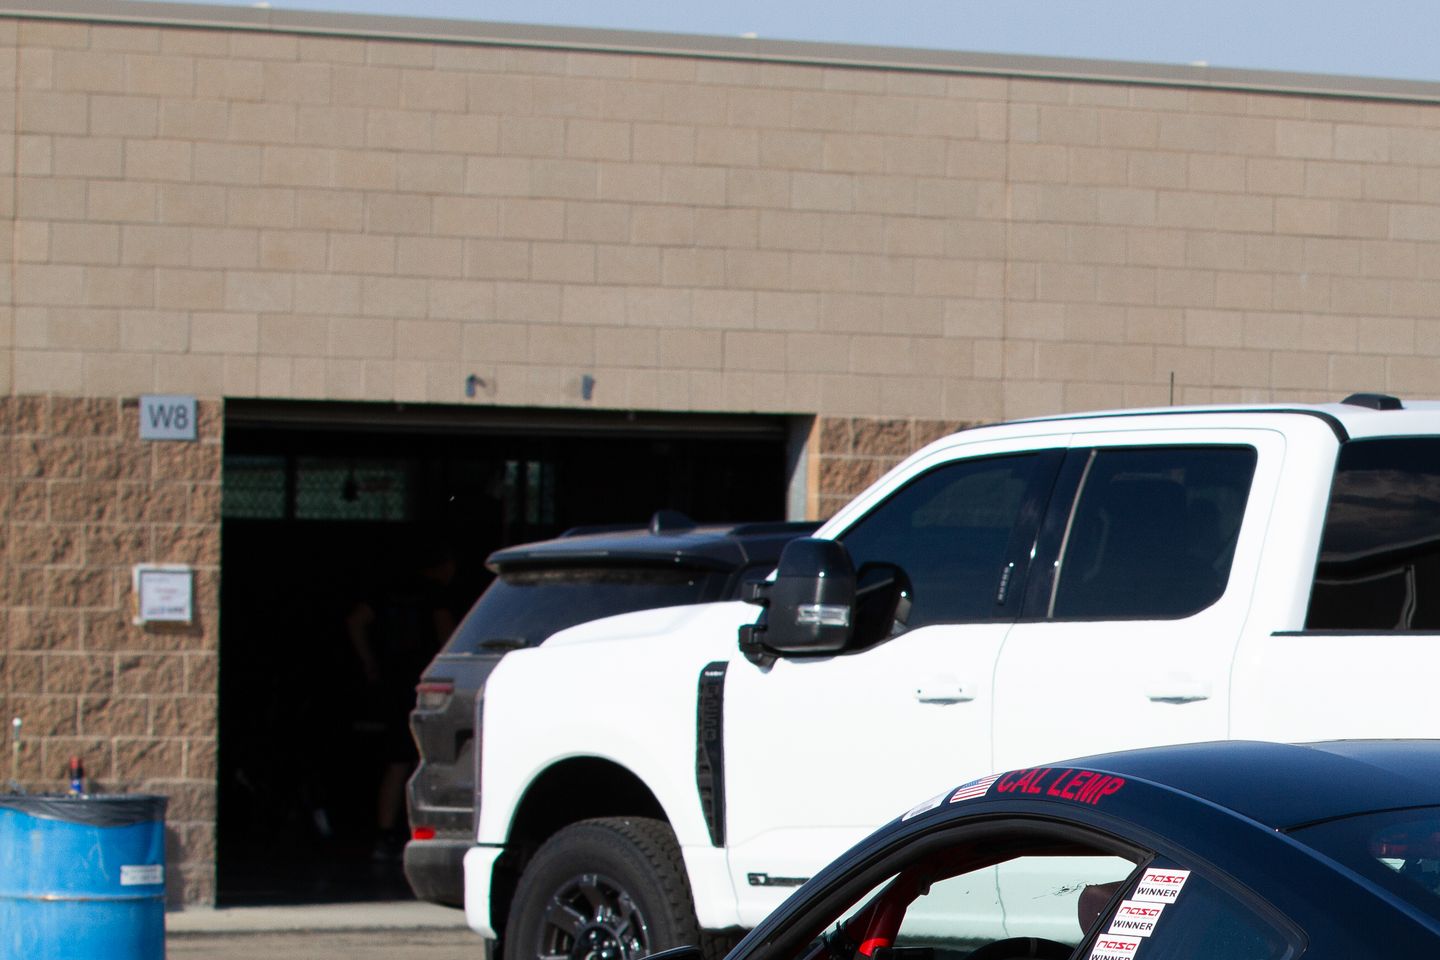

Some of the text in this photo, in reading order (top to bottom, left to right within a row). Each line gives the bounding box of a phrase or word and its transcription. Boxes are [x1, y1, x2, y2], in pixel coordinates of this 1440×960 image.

[147, 404, 188, 429] W8
[997, 767, 1127, 805] CAL LEMP
[1137, 887, 1178, 898] WINNER
[1113, 919, 1153, 931] WINNER
